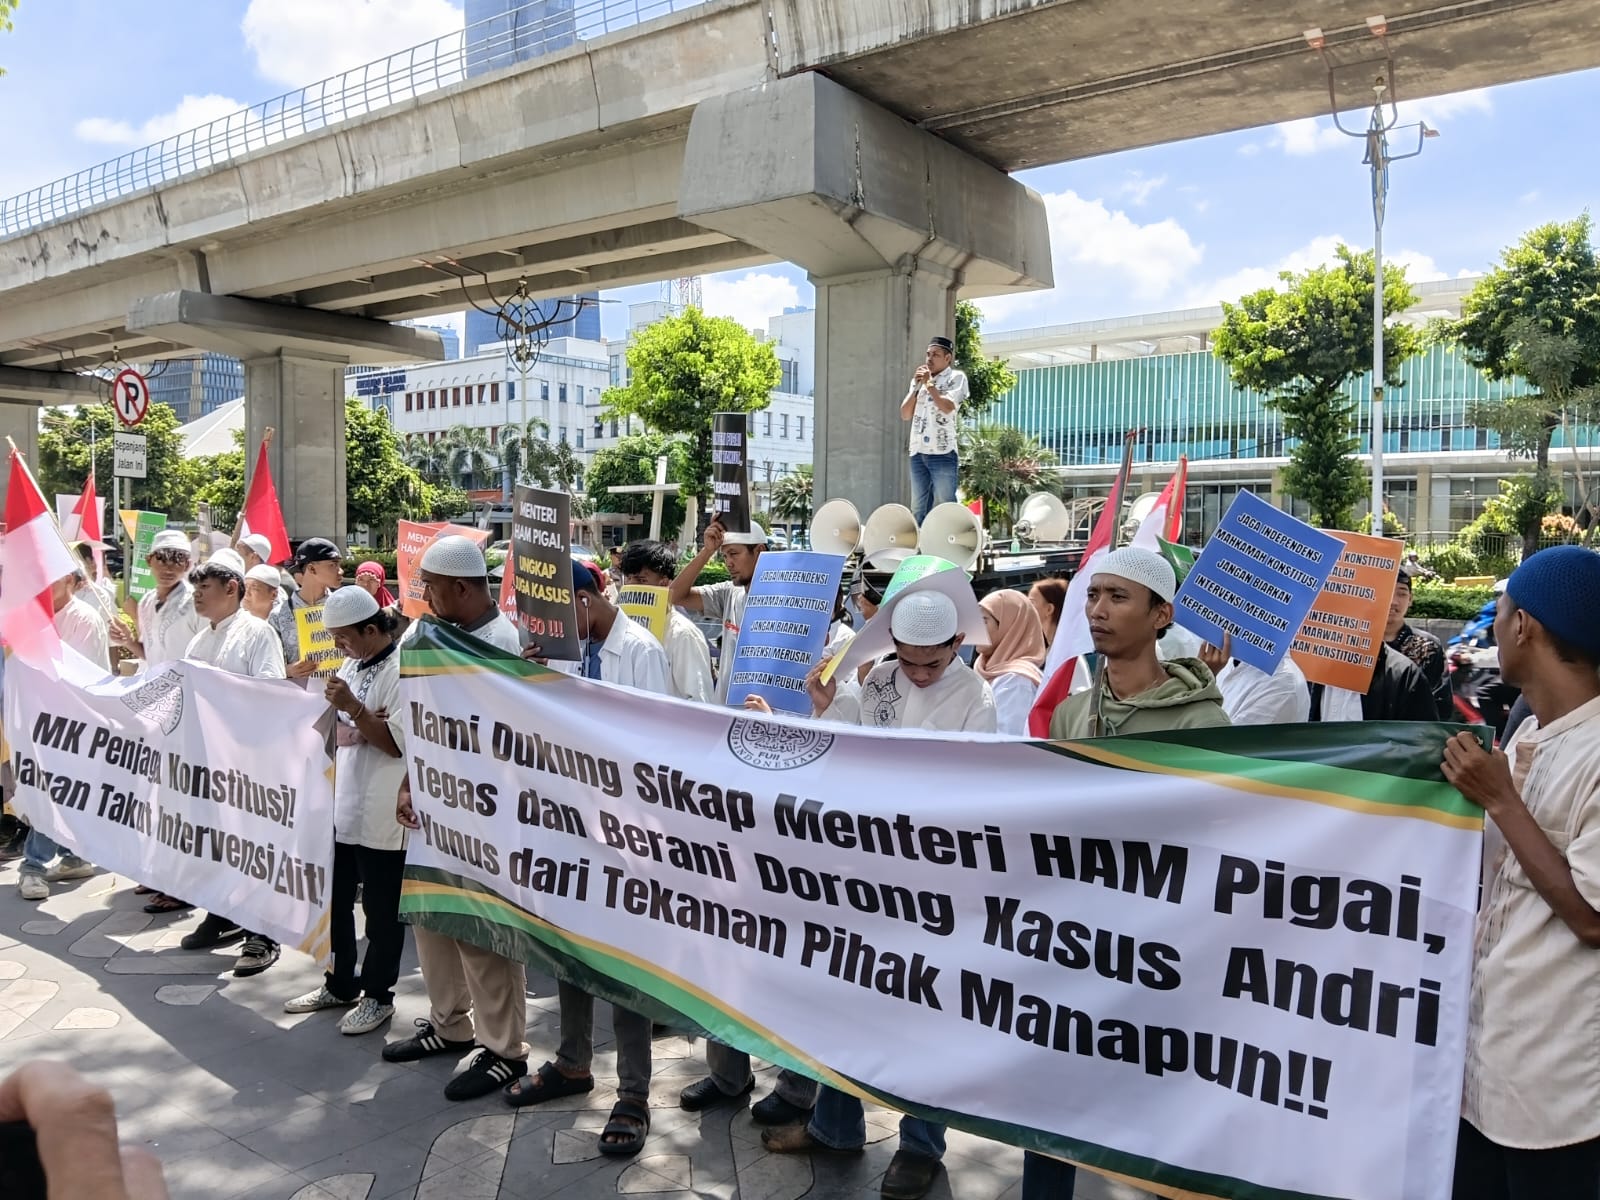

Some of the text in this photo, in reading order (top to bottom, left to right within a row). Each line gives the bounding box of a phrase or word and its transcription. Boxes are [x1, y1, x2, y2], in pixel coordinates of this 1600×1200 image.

[125, 382, 139, 414] P
[115, 440, 145, 455] Sepanjang
[118, 459, 133, 469] Jalan
[520, 501, 557, 523] MENTERI
[514, 523, 564, 552] HAM PIGAI,
[1215, 528, 1266, 563] MAHKAMAH
[1237, 512, 1322, 563] JAGA INDEPENDENSI
[519, 555, 556, 579] UNGKAP
[1331, 566, 1355, 579] ALAH
[1344, 552, 1394, 570] KONSTITUSI
[760, 571, 829, 585] JAGA INDEPENDENSI
[1216, 559, 1252, 585] JANGAN
[1252, 576, 1292, 605] BIARKAN
[531, 582, 571, 605] KASUS
[747, 595, 783, 607] MAHKAMAH
[1194, 574, 1289, 632] INTERVENSI MERUSAK
[1181, 594, 1241, 636] KEPERCAYAAN
[1308, 610, 1370, 632] INTERVENSI !!!
[549, 619, 564, 638] !!!
[751, 620, 810, 636] JANGAN BIARKAN
[1302, 626, 1371, 650] MARWAH TNI !!!
[772, 647, 811, 665] MERUSAK
[1312, 645, 1362, 664] KONSTITUSI
[1363, 655, 1373, 667] !!!
[734, 745, 807, 768] INDONESIA
[32, 711, 88, 754] MK
[168, 752, 297, 829] Konstitusi!
[411, 701, 1446, 954] Kami Dukung Sikap Menteri HAM Pigai,
[97, 782, 152, 837] Takut
[156, 804, 275, 884] Intervensi
[274, 850, 325, 909] Elit!
[414, 756, 1441, 1047] Tegas dan Berani Dorong Kasus Andri
[418, 810, 1333, 1120] Yunus dari Tekanan Pihak Manapun!!
